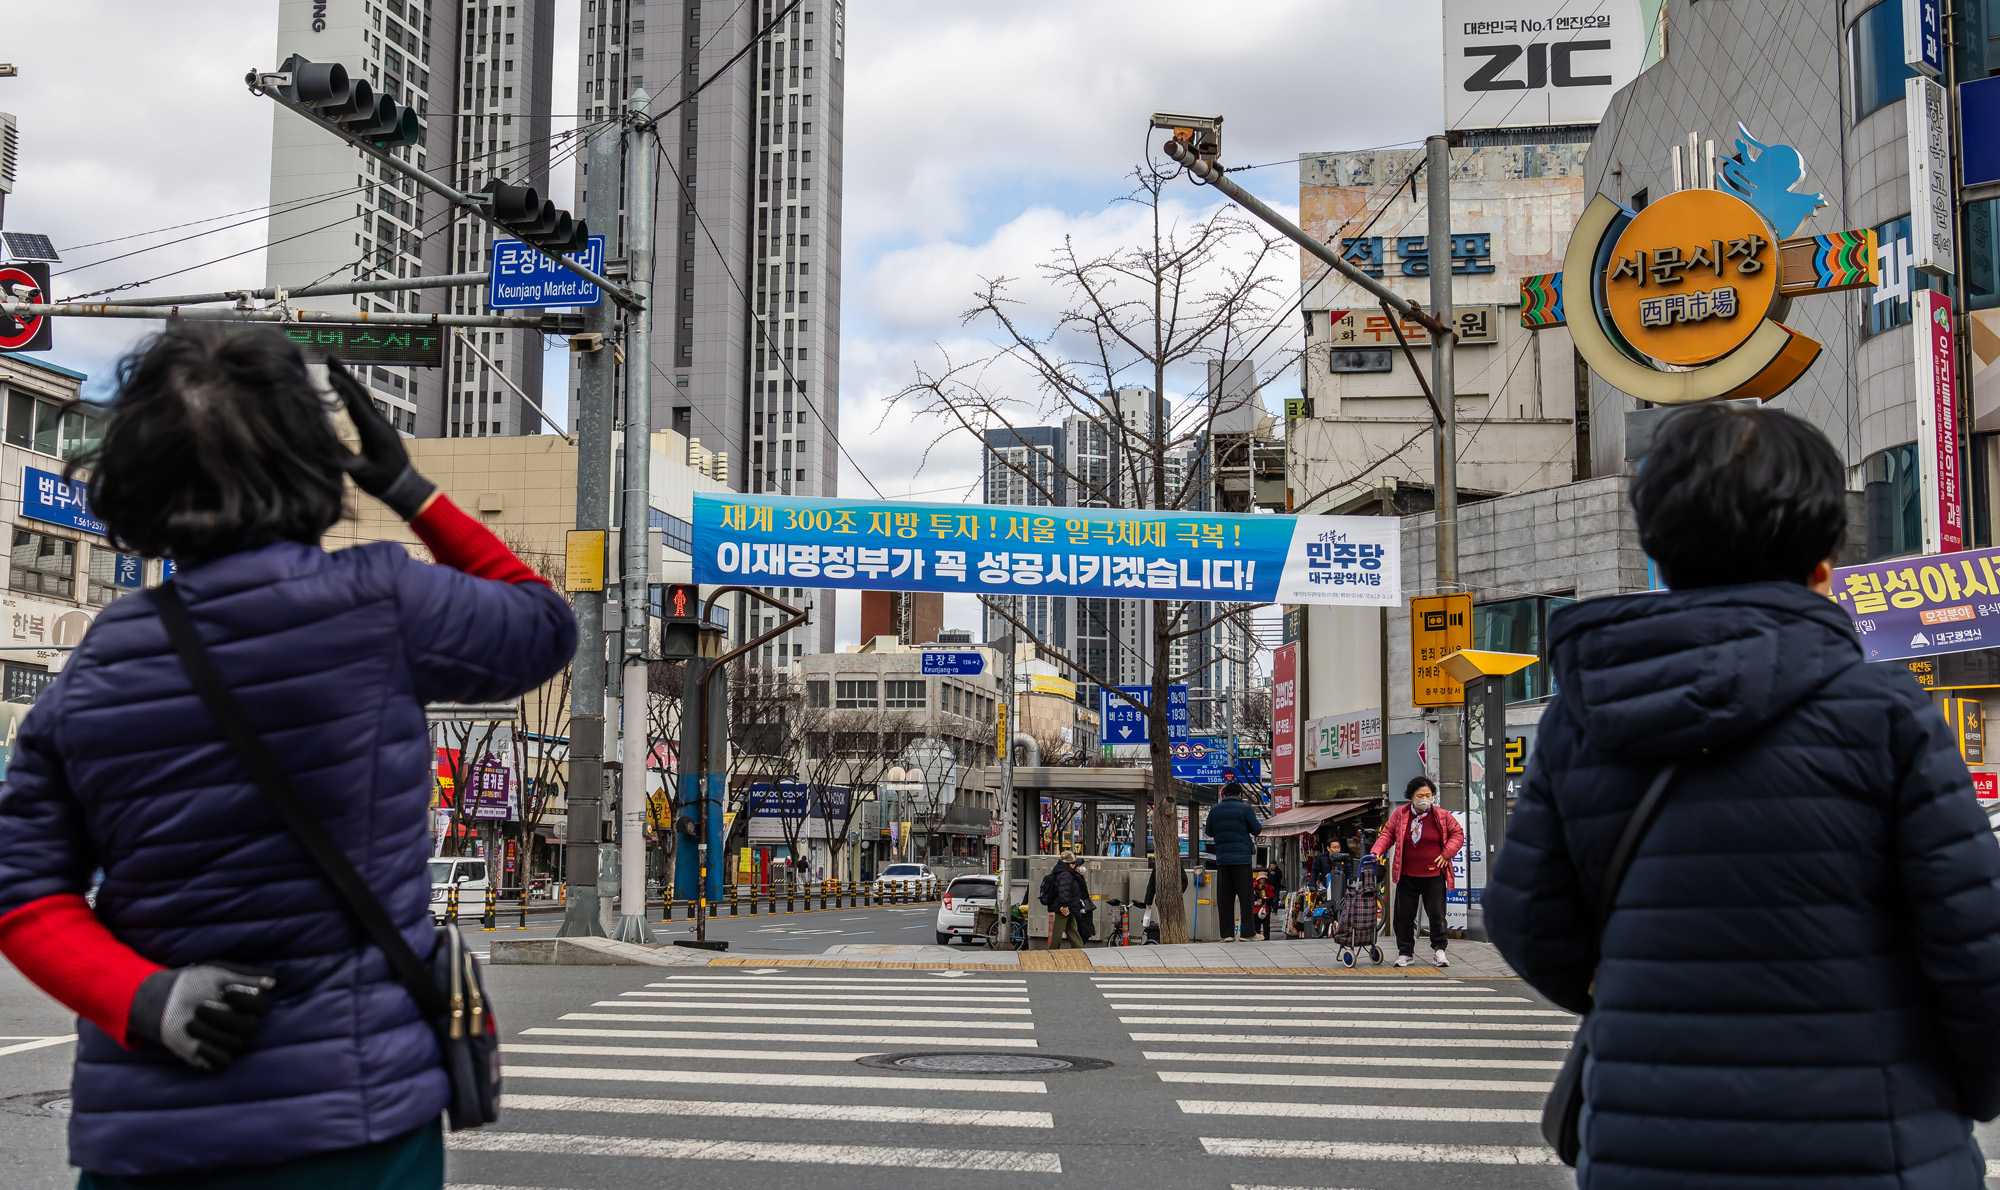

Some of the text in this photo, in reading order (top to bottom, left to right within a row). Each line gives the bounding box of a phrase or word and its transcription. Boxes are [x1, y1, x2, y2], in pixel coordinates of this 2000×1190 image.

[1464, 15, 1611, 36] 대한민국 No.1 엔진오일
[1463, 39, 1612, 92] ZIC
[1341, 232, 1496, 279] 전당포
[1610, 234, 1768, 288] 서문시장
[498, 280, 593, 301] Keunjang Market Jct
[1642, 290, 1734, 325] 西門市場
[1363, 310, 1488, 343] 무도원
[720, 504, 774, 533] 재계
[783, 508, 859, 535] 300조
[866, 511, 921, 540] 지방
[928, 513, 982, 541] 투자
[1005, 516, 1057, 545] 서울
[1065, 519, 1167, 549] 일극체제
[1175, 523, 1225, 550] 극복
[1317, 529, 1347, 545] 더불어
[716, 541, 1256, 591] 이재명정부가 꼭 성공시키겠습니다!
[1306, 543, 1385, 570] 민주당
[1308, 571, 1382, 587] 대구광역시당
[1828, 556, 2000, 615] ·칠성야시
[1289, 611, 1300, 638] 전문
[1925, 606, 1971, 623] 모집분야
[12, 612, 45, 643] 한복
[1936, 627, 1982, 642] 대구광역시
[924, 654, 957, 666] 큰장로
[924, 666, 959, 675] Keunjang-ro
[1417, 665, 1440, 679] 카메라
[1425, 686, 1461, 696] 중부경찰서
[1108, 711, 1142, 722] 버스전용
[1171, 708, 1186, 721] 19:30
[1320, 720, 1360, 758] 그린커텐
